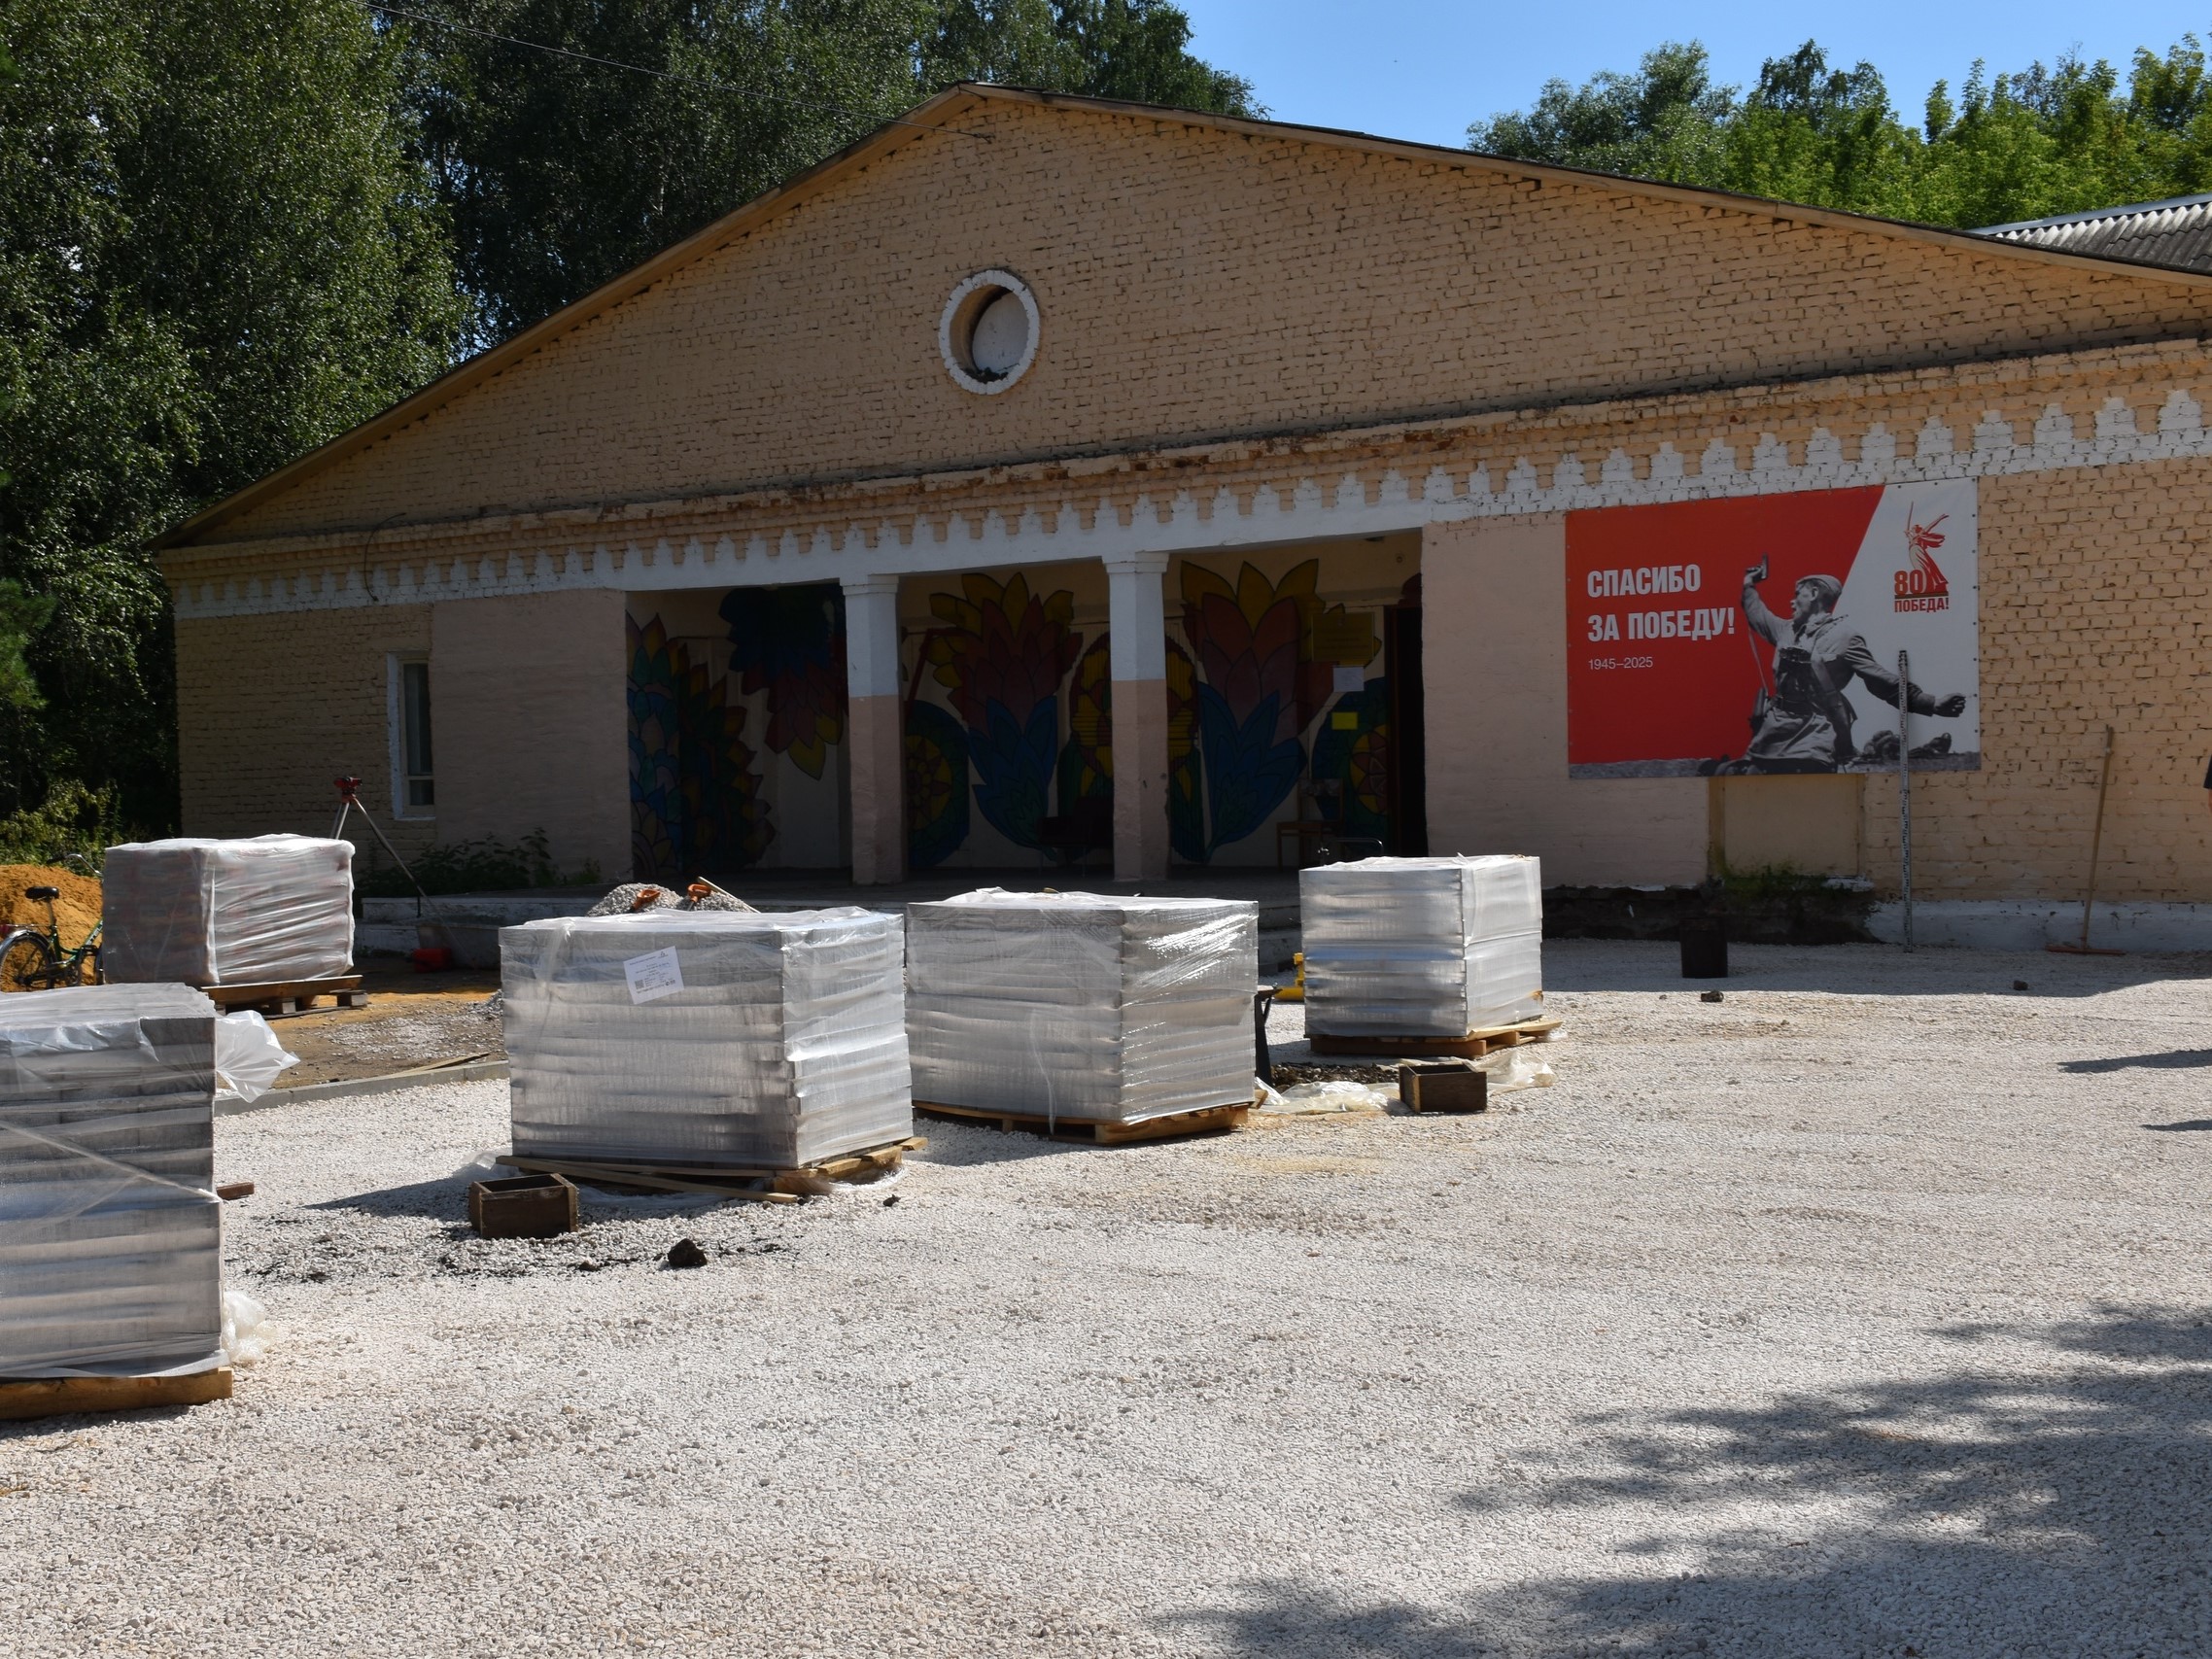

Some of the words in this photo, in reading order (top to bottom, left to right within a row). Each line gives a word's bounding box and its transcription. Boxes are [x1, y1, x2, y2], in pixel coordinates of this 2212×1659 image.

[1587, 564, 1701, 598] СПАСИБО
[1894, 570, 1924, 595] 80
[1894, 597, 1950, 613] ПОБЕДА!
[1587, 614, 1620, 641] ЗА
[1628, 607, 1735, 641] ПОБЕДУ!
